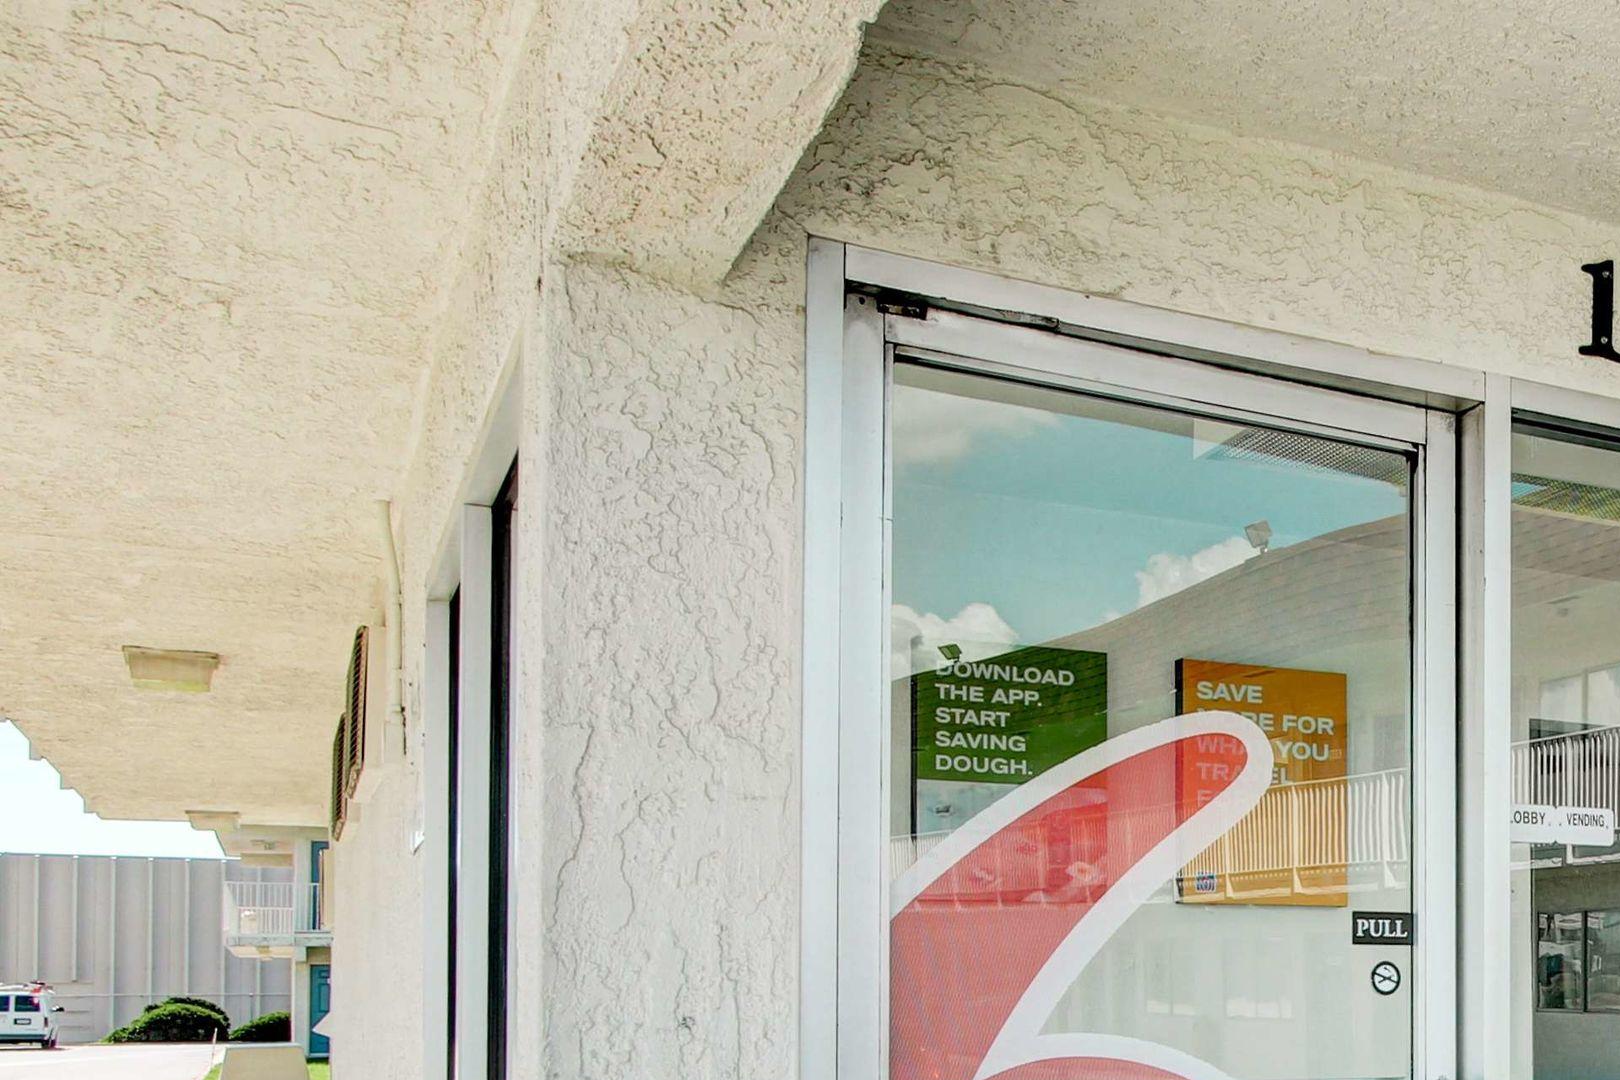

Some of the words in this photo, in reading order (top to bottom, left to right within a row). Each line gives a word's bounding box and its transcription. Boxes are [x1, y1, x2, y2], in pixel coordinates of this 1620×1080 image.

[935, 660, 1075, 686] DOWNLOAD
[935, 683, 984, 702] THE
[991, 687, 1042, 707] APP.
[1196, 681, 1263, 704] SAVE
[935, 707, 1010, 727] START
[1282, 715, 1334, 735] FOR
[935, 730, 1027, 752] SAVING
[1276, 741, 1330, 761] YOU
[935, 754, 1033, 775] DOUGH.
[1510, 810, 1547, 825] OBBY
[1356, 918, 1408, 938] PULL
